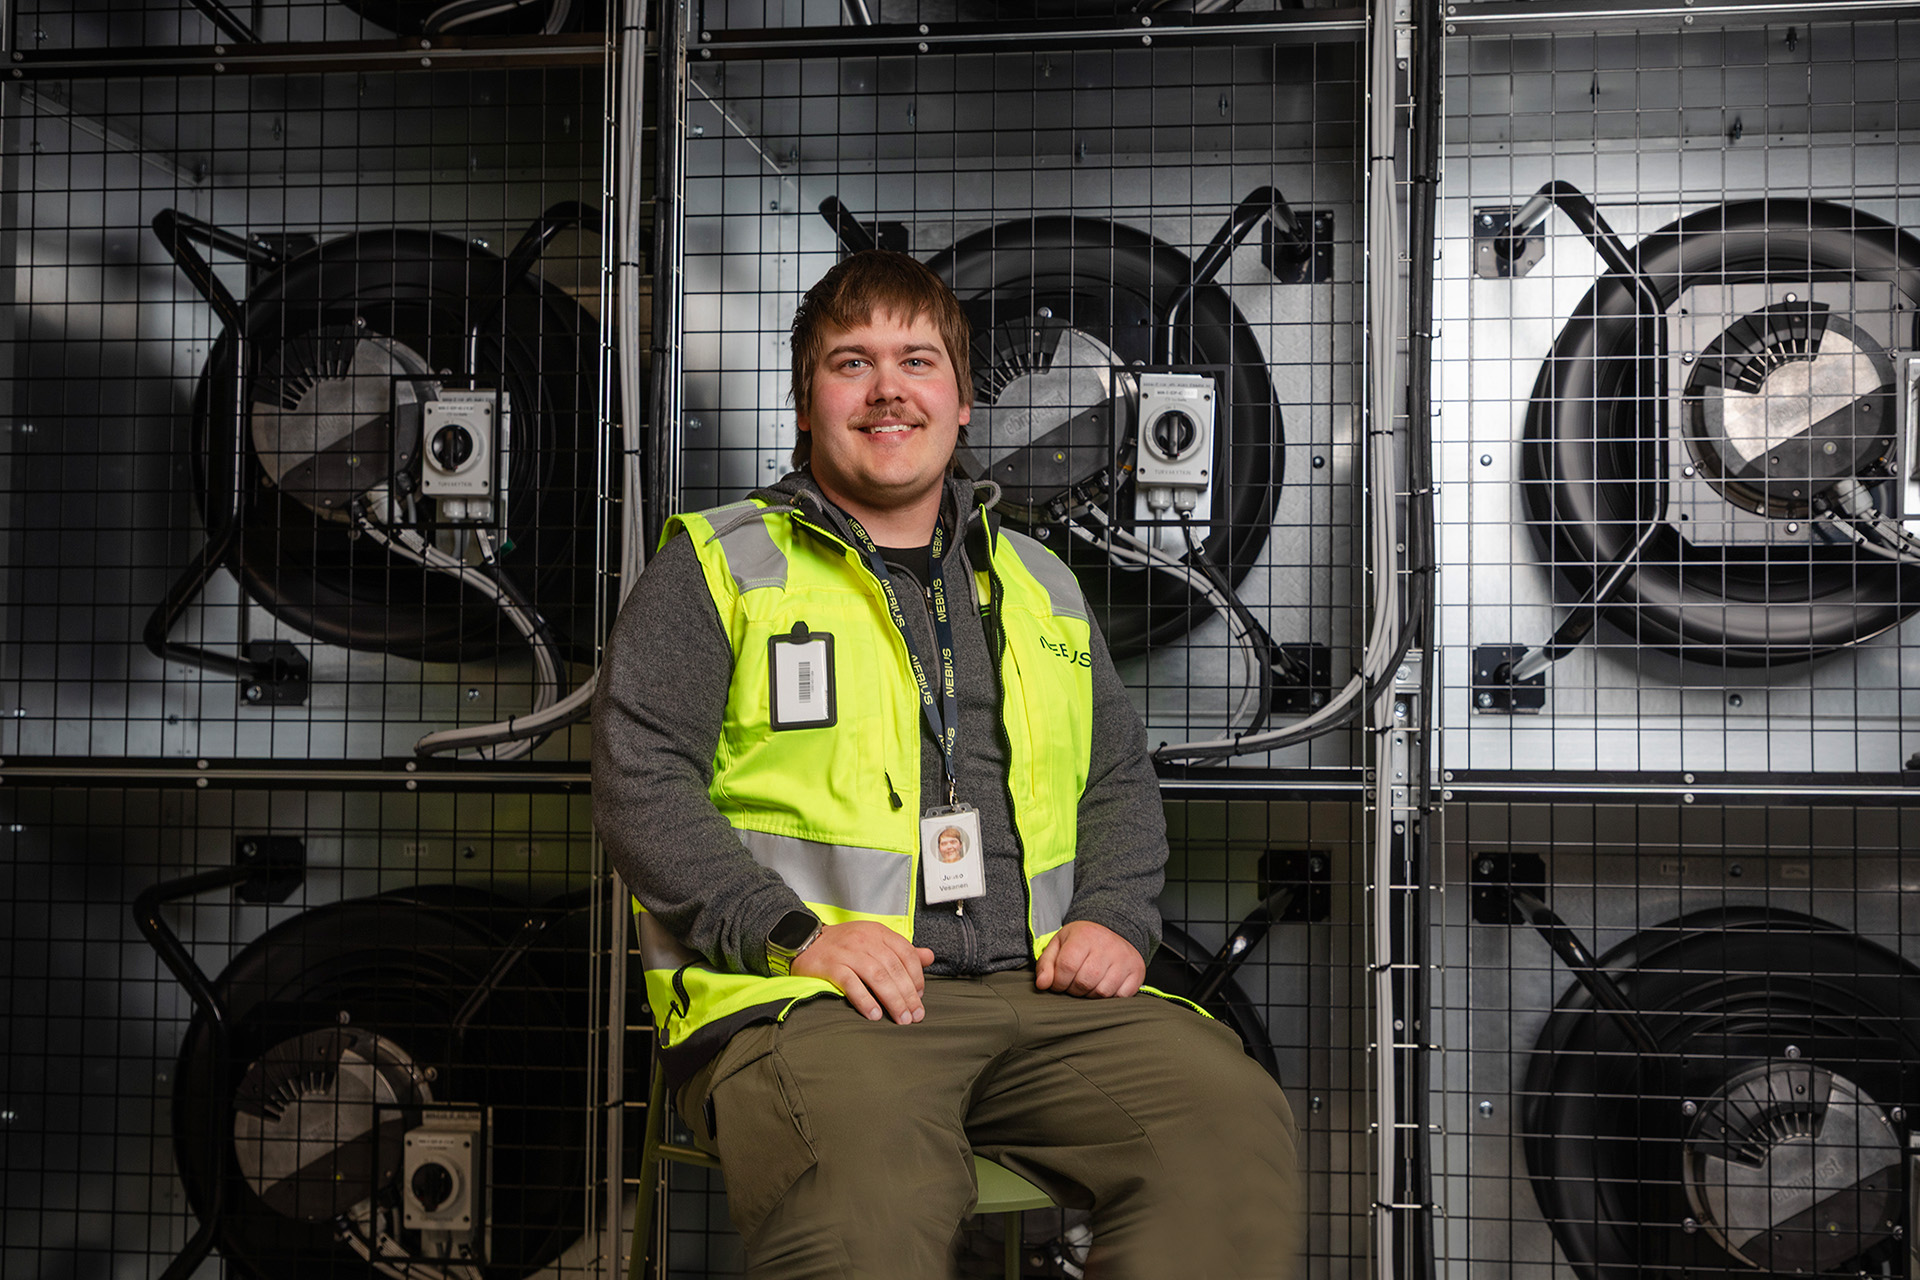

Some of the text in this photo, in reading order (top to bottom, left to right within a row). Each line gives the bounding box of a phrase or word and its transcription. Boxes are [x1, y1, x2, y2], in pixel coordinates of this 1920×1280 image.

[846, 518, 877, 553] NEBIUS
[932, 528, 944, 559] NEBIUS
[881, 579, 906, 628] NEBIUS
[933, 578, 947, 623] NEBIUS
[911, 654, 933, 706] NEBIUS
[942, 648, 955, 698] NEBIUS
